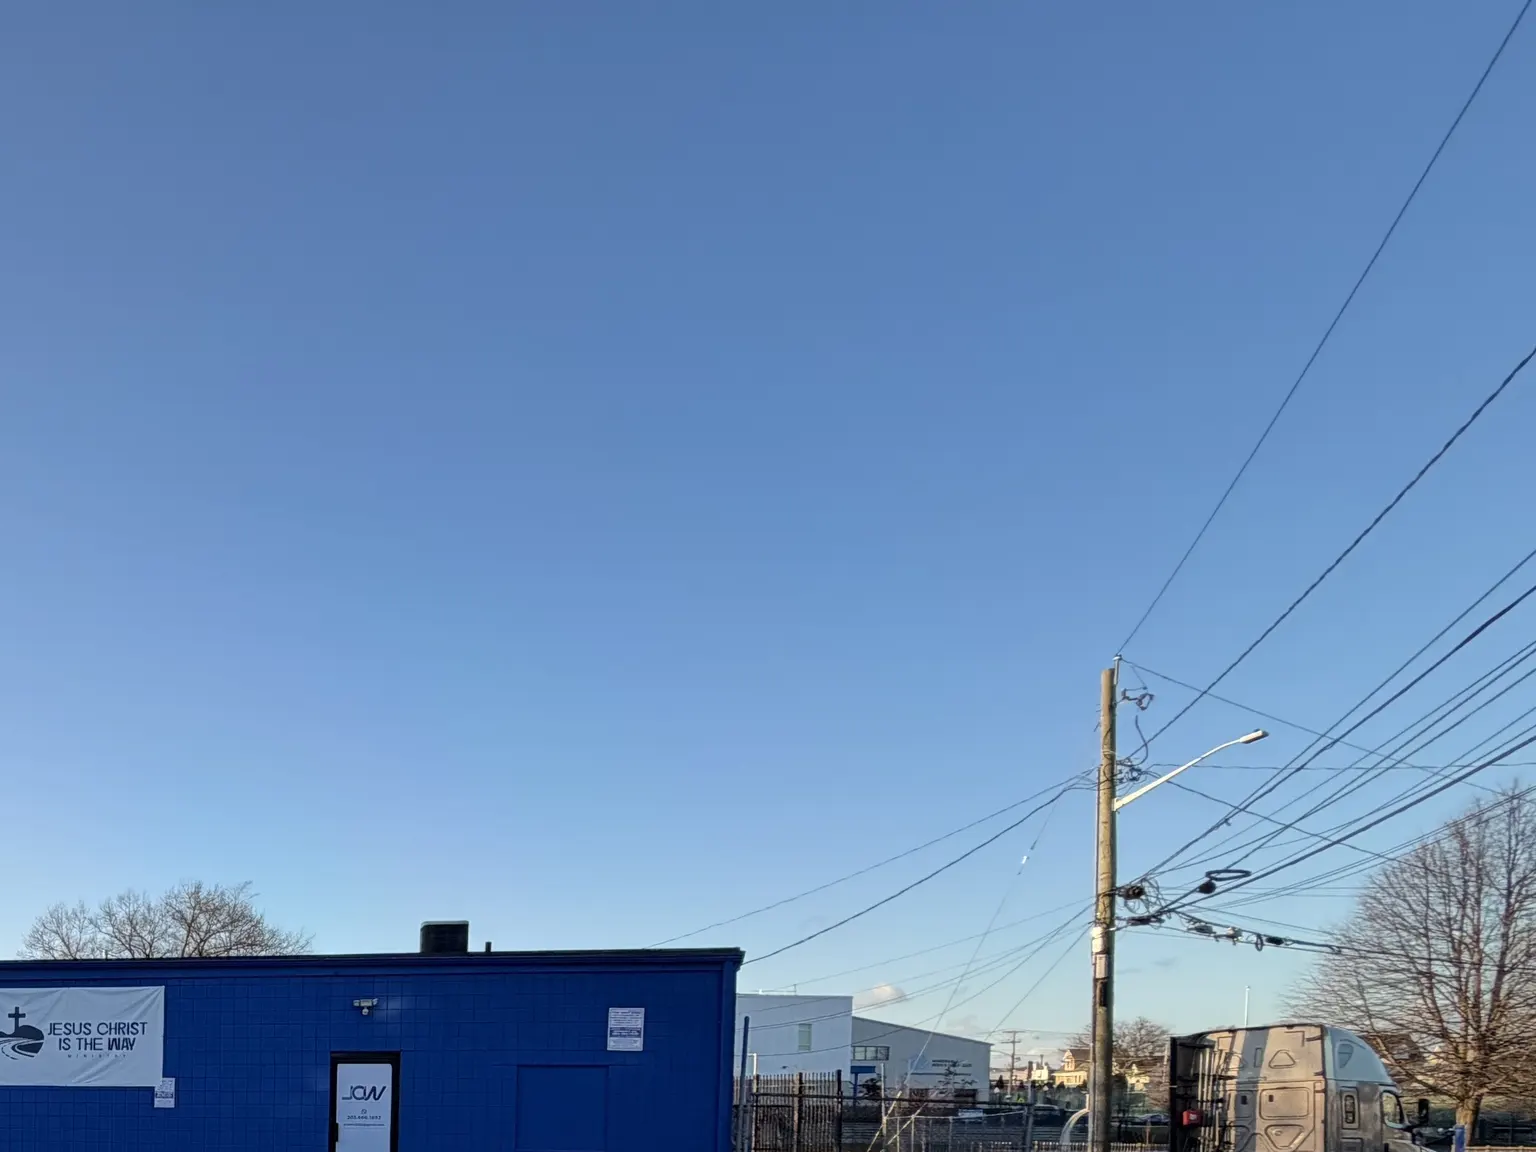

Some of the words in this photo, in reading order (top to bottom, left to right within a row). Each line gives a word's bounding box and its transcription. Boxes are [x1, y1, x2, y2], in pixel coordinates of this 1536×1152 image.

[47, 1022, 91, 1036] JESUS
[96, 1021, 148, 1036] CHRIST
[58, 1037, 71, 1051] IS
[76, 1037, 104, 1051] THE
[107, 1037, 136, 1051] WAY
